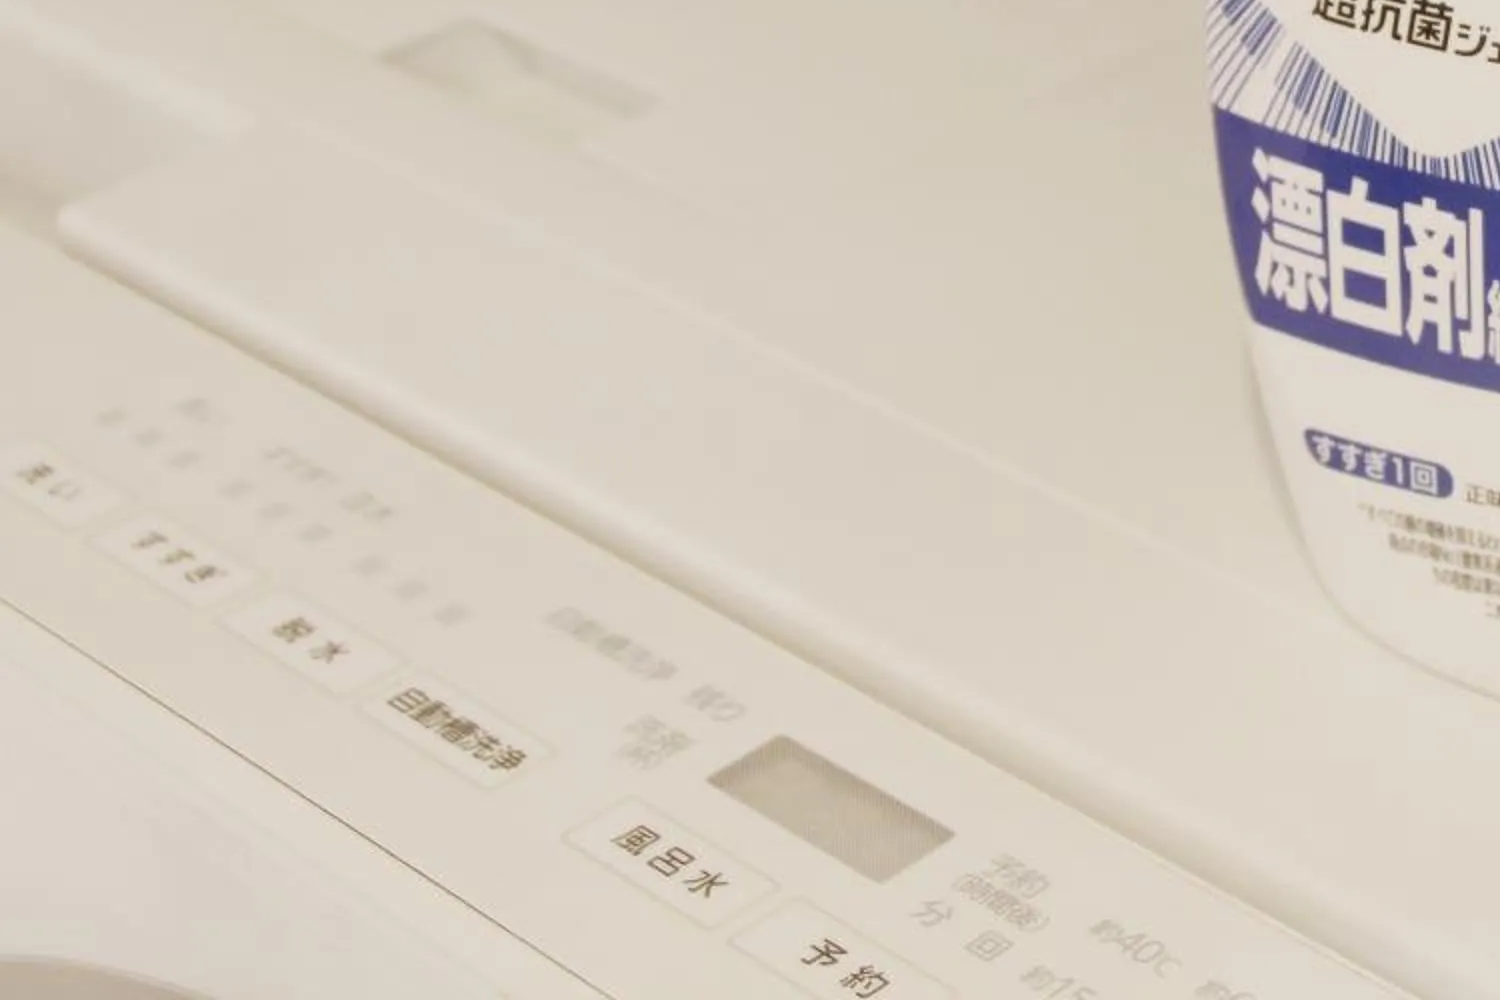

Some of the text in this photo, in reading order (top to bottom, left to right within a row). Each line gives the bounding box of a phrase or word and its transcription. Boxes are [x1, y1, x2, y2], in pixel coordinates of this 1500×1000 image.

[1311, 434, 1438, 495] すすぎ1回
[387, 686, 527, 771] 自動槽洗浄
[611, 823, 729, 899] 風呂水
[910, 899, 955, 928] 分
[799, 938, 891, 999] 予約
